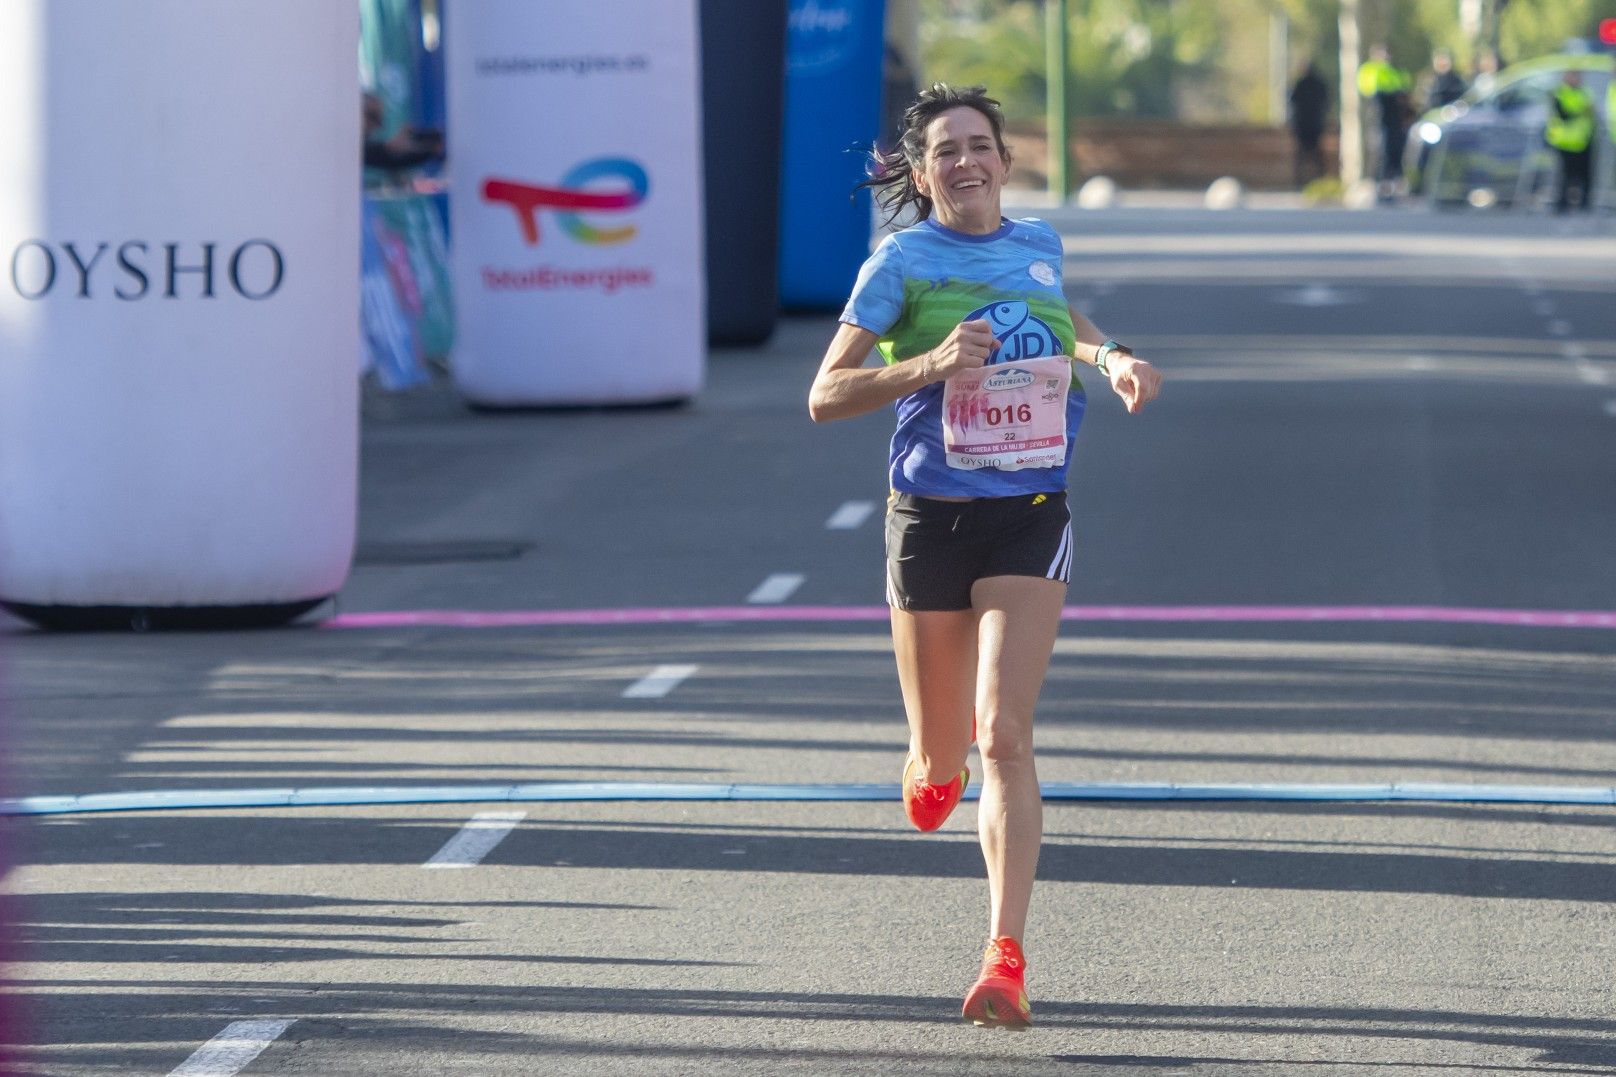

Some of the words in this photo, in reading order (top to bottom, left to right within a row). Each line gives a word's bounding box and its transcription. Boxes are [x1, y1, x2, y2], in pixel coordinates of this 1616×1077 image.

[10, 238, 284, 301] OYSHO
[482, 265, 655, 293] TotalEnergies
[1005, 332, 1045, 362] JD
[986, 403, 1032, 426] 016
[1004, 432, 1016, 441] 22
[964, 445, 992, 454] CARRERA
[960, 456, 1001, 468] OYSHO
